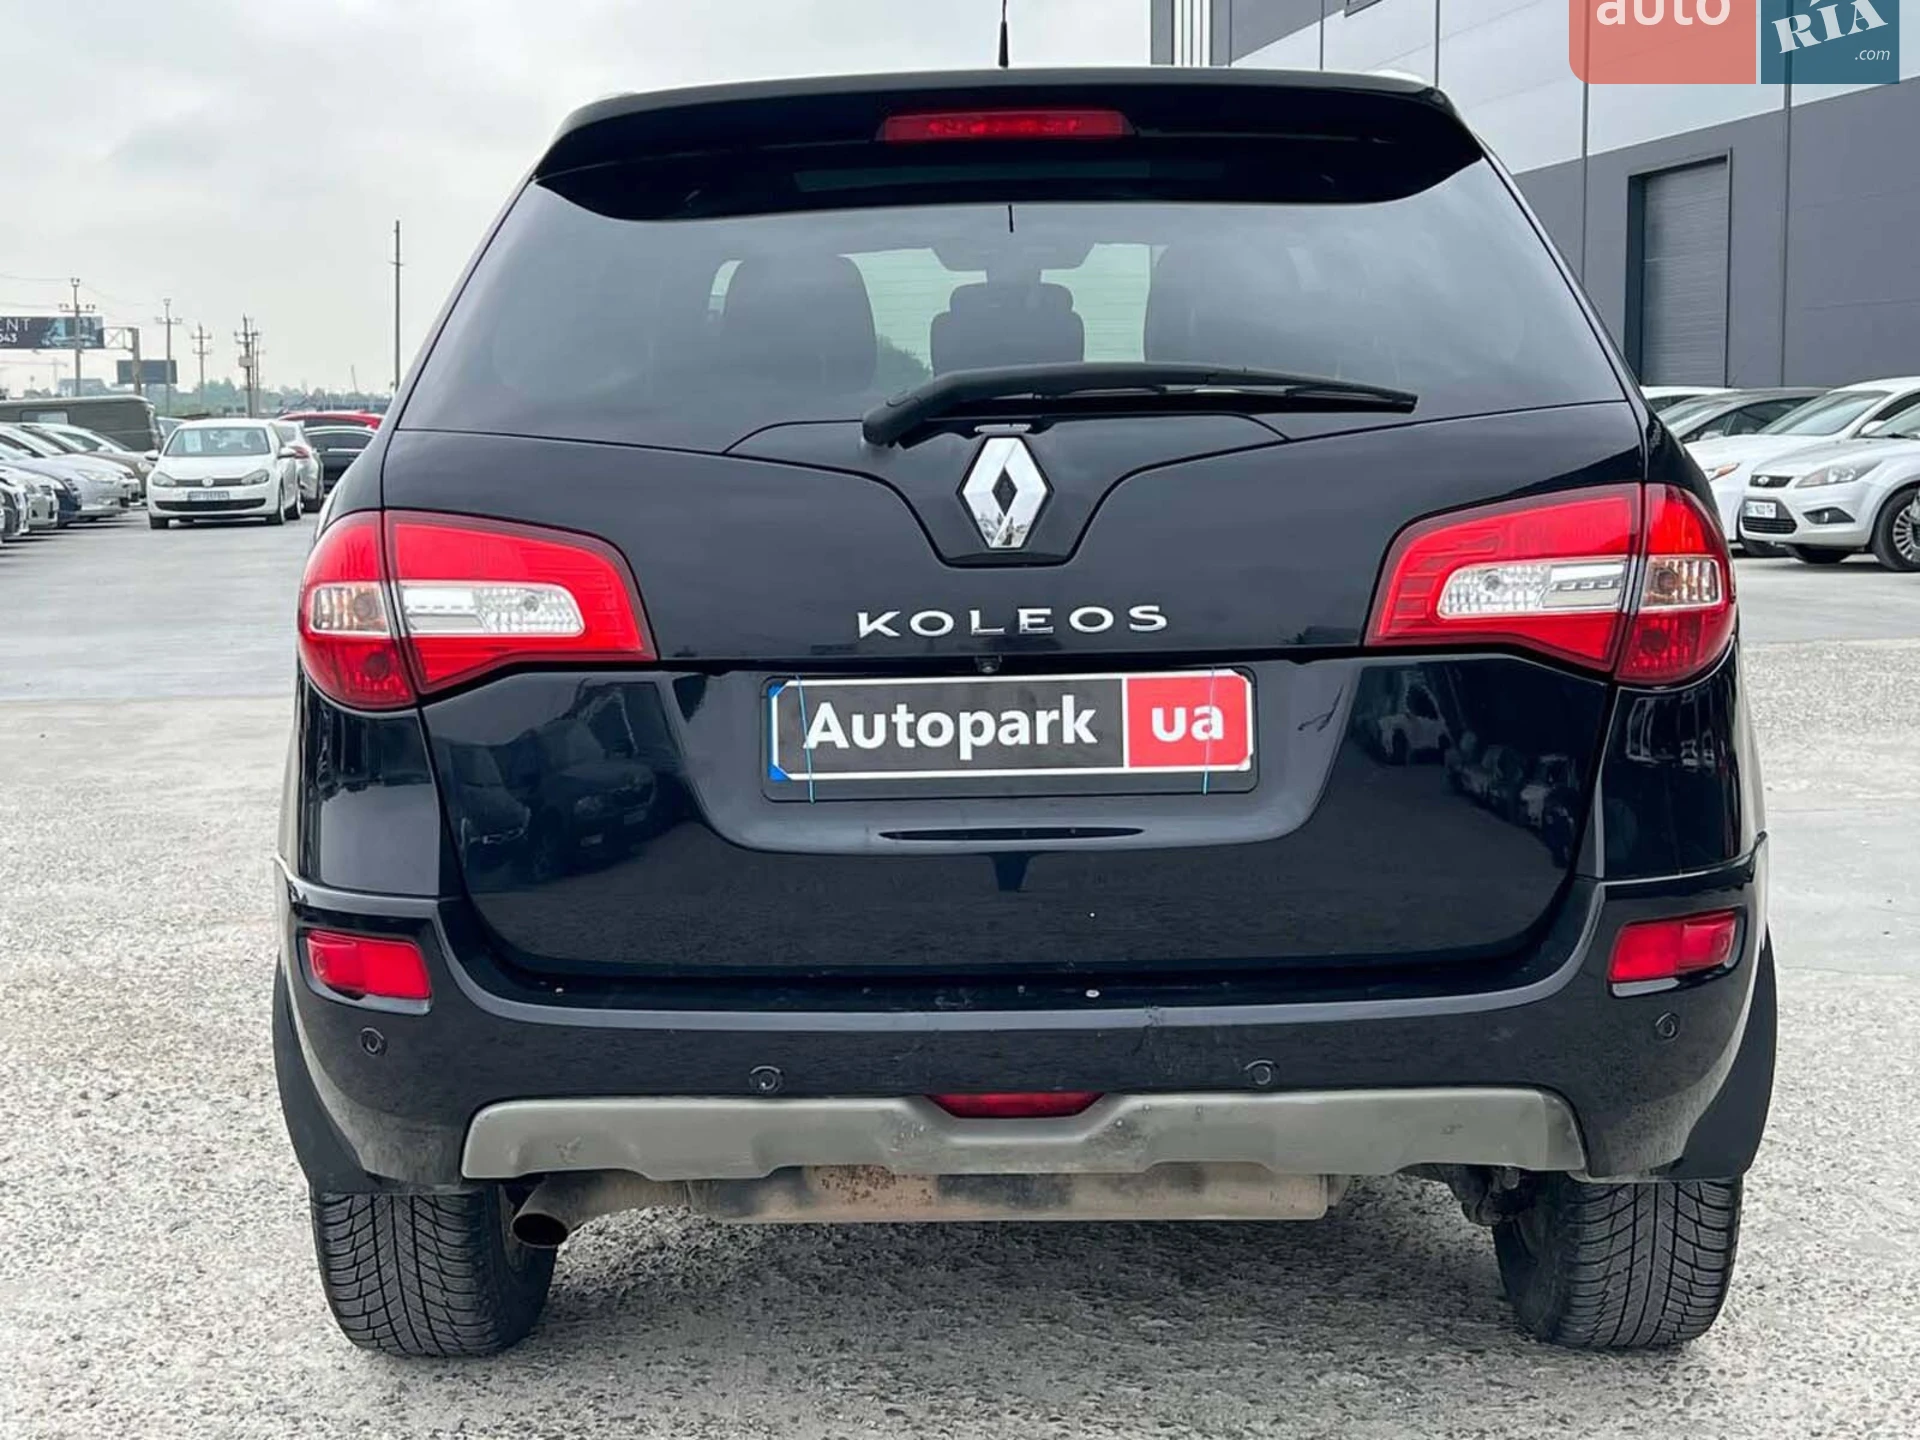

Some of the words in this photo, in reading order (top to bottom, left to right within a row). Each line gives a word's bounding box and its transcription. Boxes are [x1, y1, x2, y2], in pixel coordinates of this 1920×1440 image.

[857, 604, 1168, 639] KOLEOS
[802, 695, 1098, 761] Autopark
[1151, 704, 1224, 743] ua
